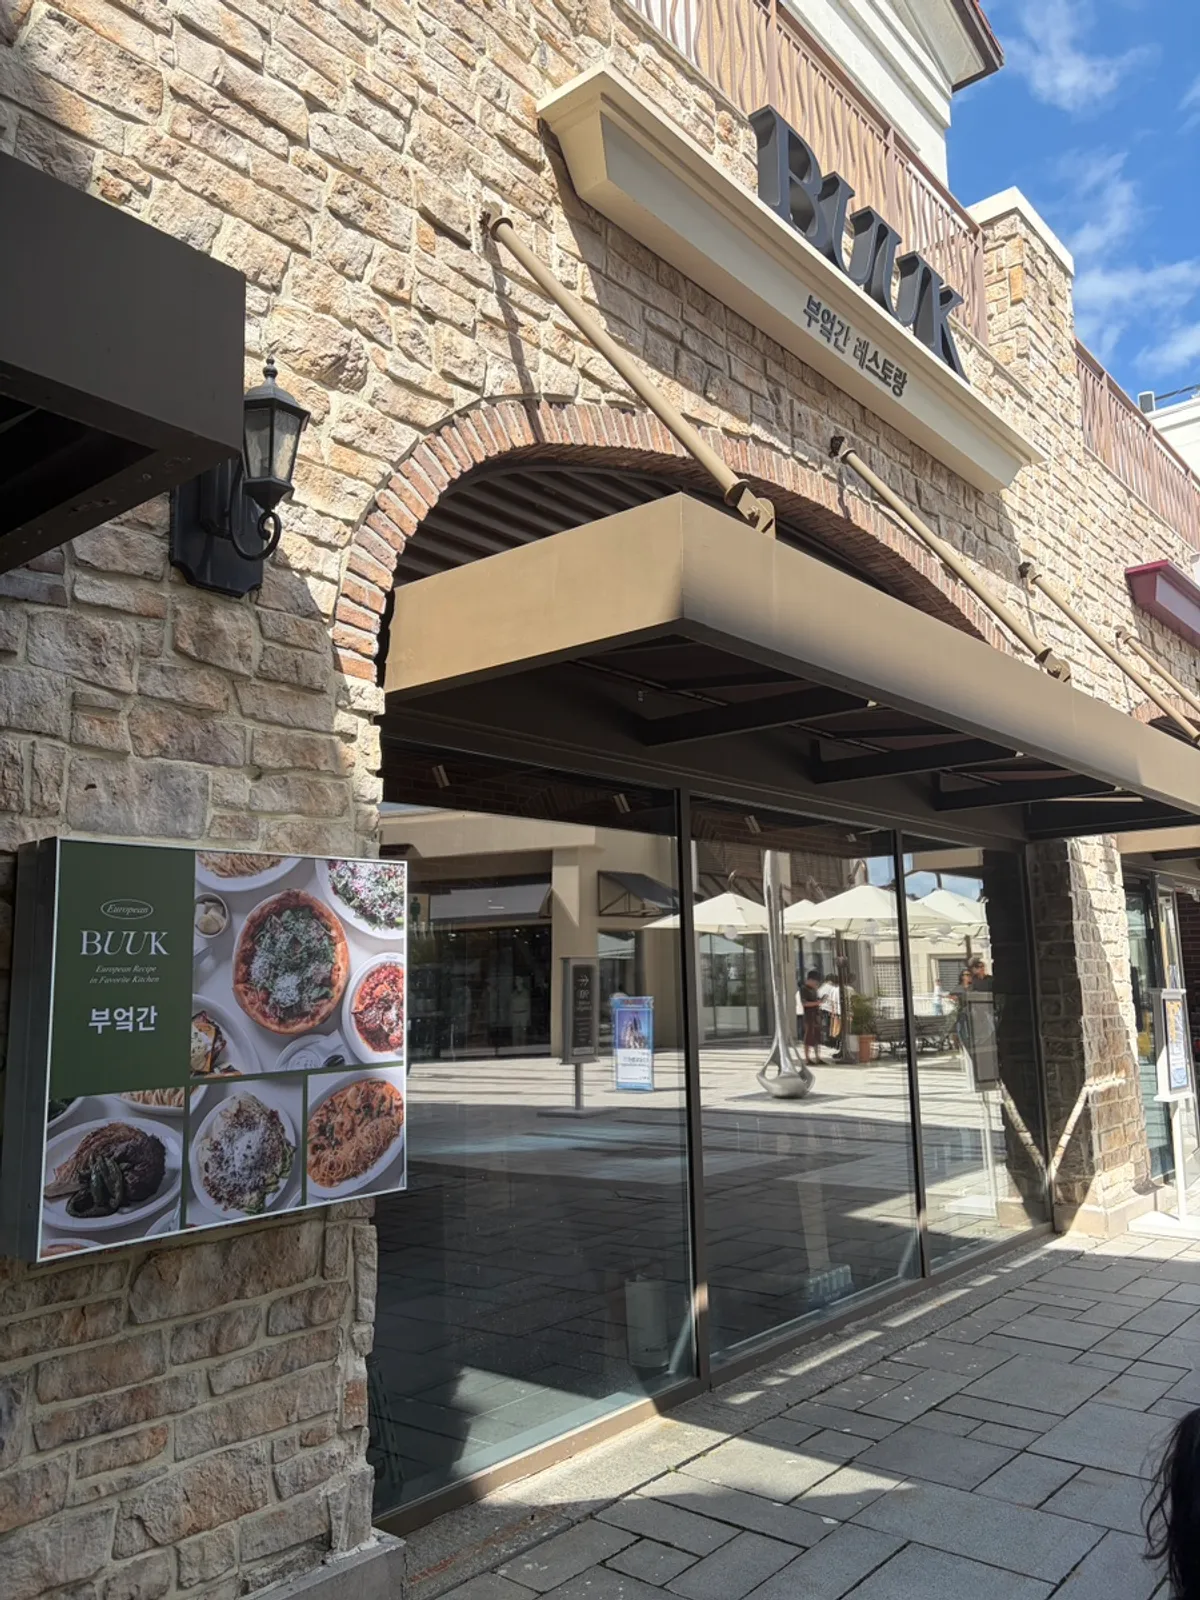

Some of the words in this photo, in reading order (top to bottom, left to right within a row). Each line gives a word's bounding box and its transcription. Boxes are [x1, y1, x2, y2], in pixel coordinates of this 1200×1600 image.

[749, 104, 971, 385] BUUK
[803, 294, 850, 355] 부엌간
[853, 337, 908, 397] 레스토랑
[106, 904, 149, 916] European
[80, 930, 170, 956] BUUK
[90, 976, 98, 984] in
[98, 976, 130, 984] Favorite
[131, 976, 160, 984] Kitchen
[95, 965, 132, 974] European
[132, 965, 157, 974] Recipe
[88, 1005, 158, 1034] 부엌간
